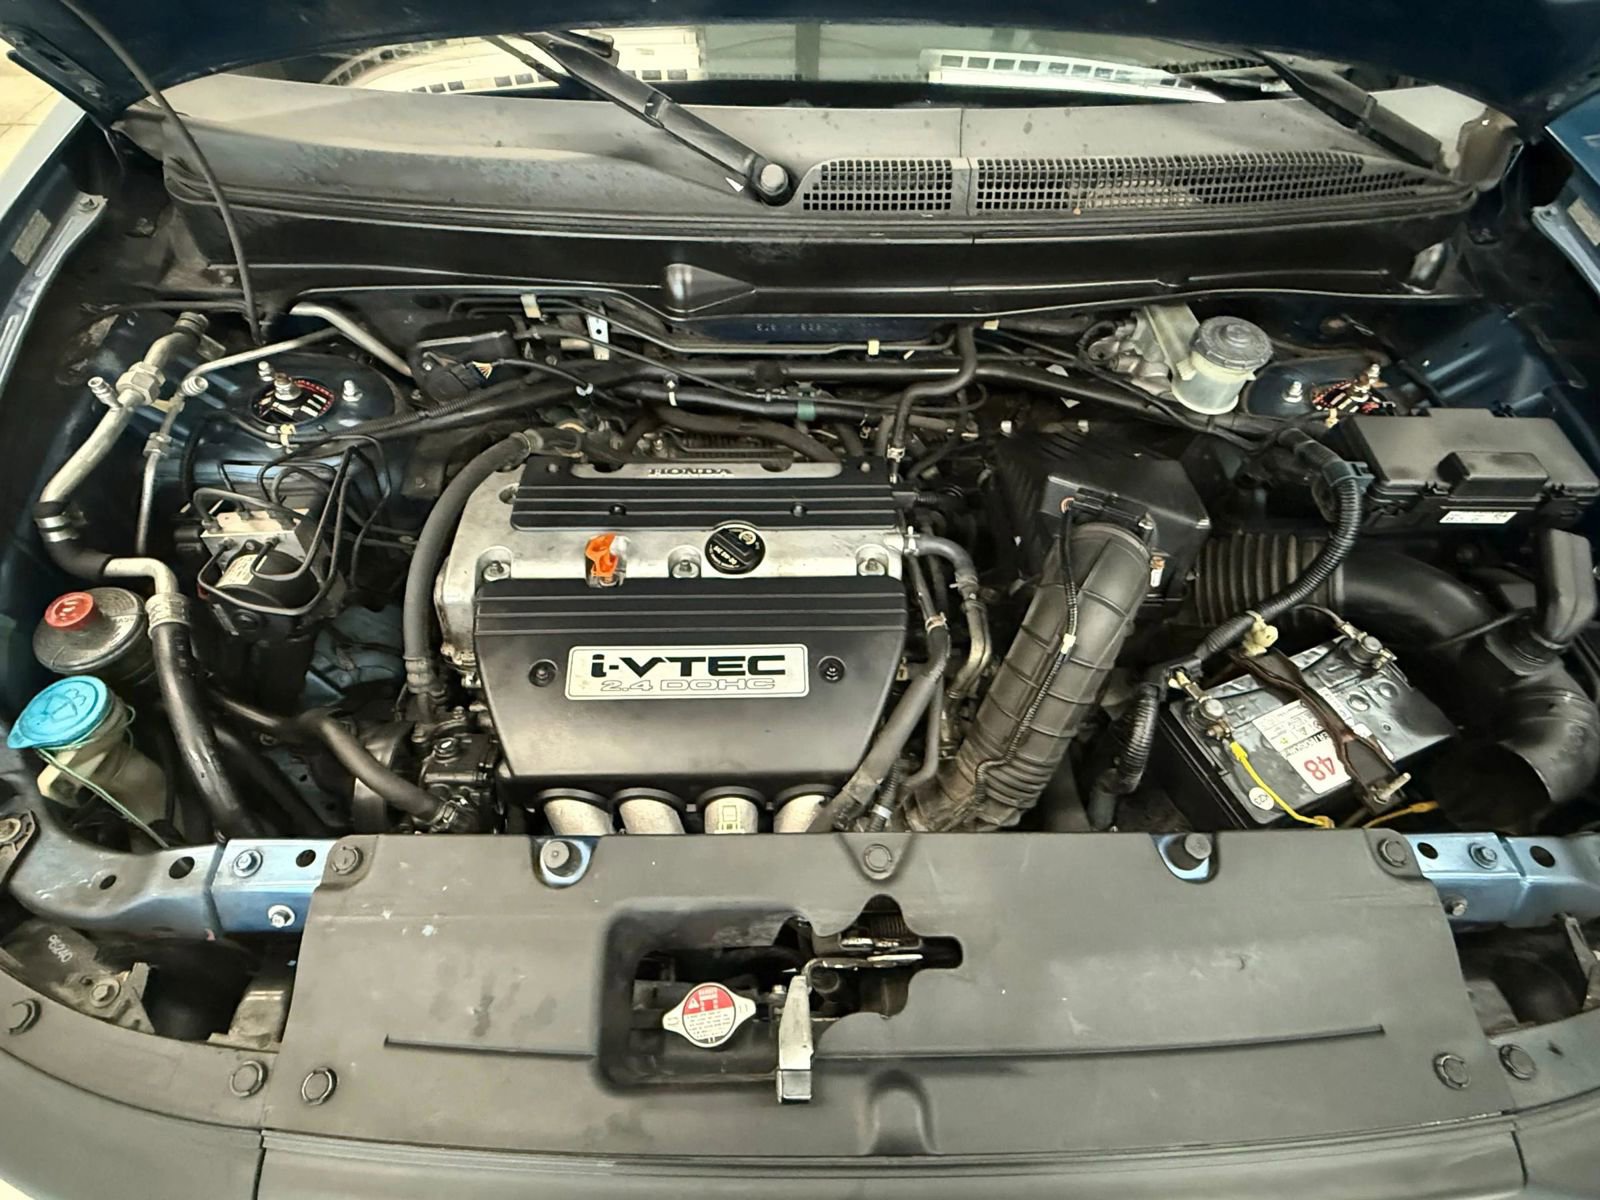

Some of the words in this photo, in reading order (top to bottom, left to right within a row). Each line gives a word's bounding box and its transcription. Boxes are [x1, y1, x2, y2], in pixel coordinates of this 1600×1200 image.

[648, 468, 733, 476] HONDA
[591, 654, 786, 678] i-VTEC
[600, 679, 654, 692] 2.4
[660, 678, 776, 692] DOHC
[1303, 756, 1335, 780] 48
